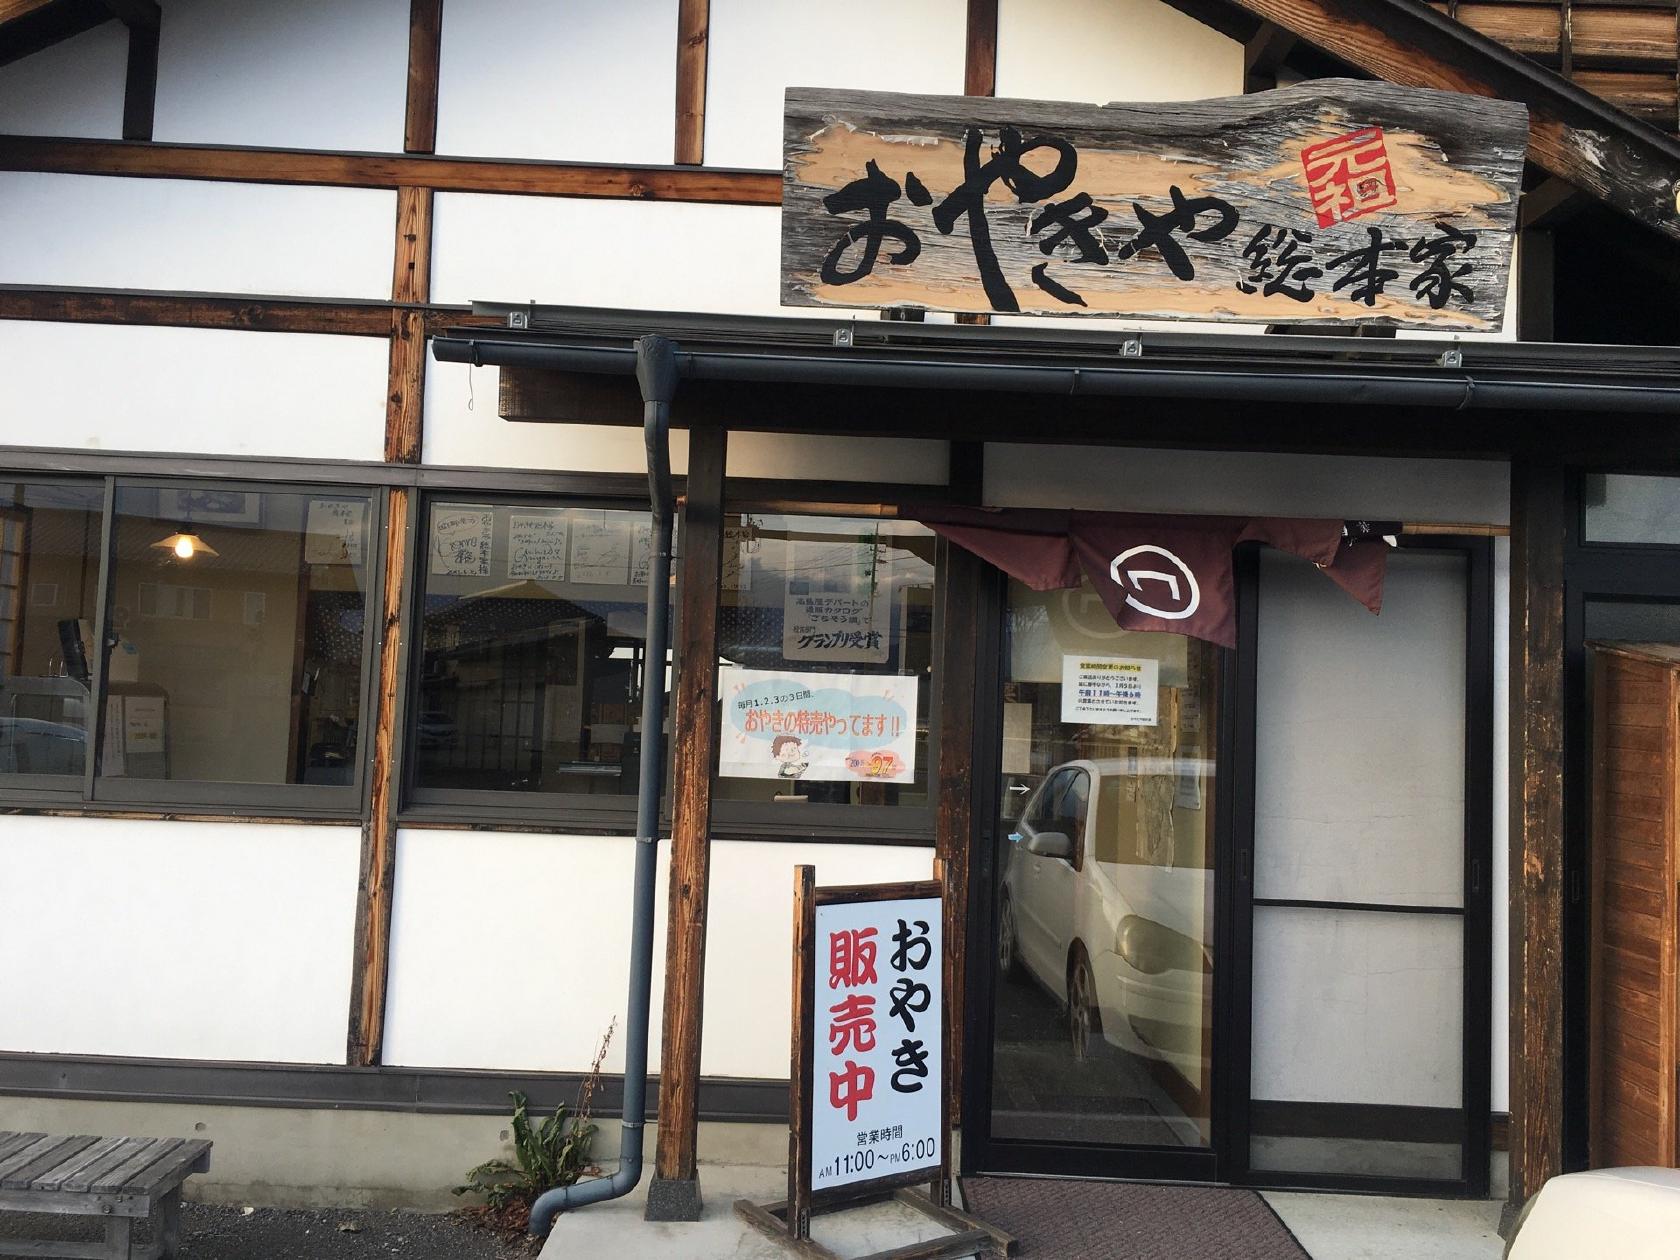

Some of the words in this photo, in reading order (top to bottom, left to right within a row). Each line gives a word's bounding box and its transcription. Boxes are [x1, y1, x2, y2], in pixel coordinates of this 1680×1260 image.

[820, 127, 1477, 313] おやきや総本家
[1301, 127, 1397, 229] 元祖
[797, 630, 882, 650] グランプリ受賞
[828, 927, 878, 1122] 販売中
[889, 918, 932, 1094] おやき
[856, 1124, 903, 1146] 営業時間
